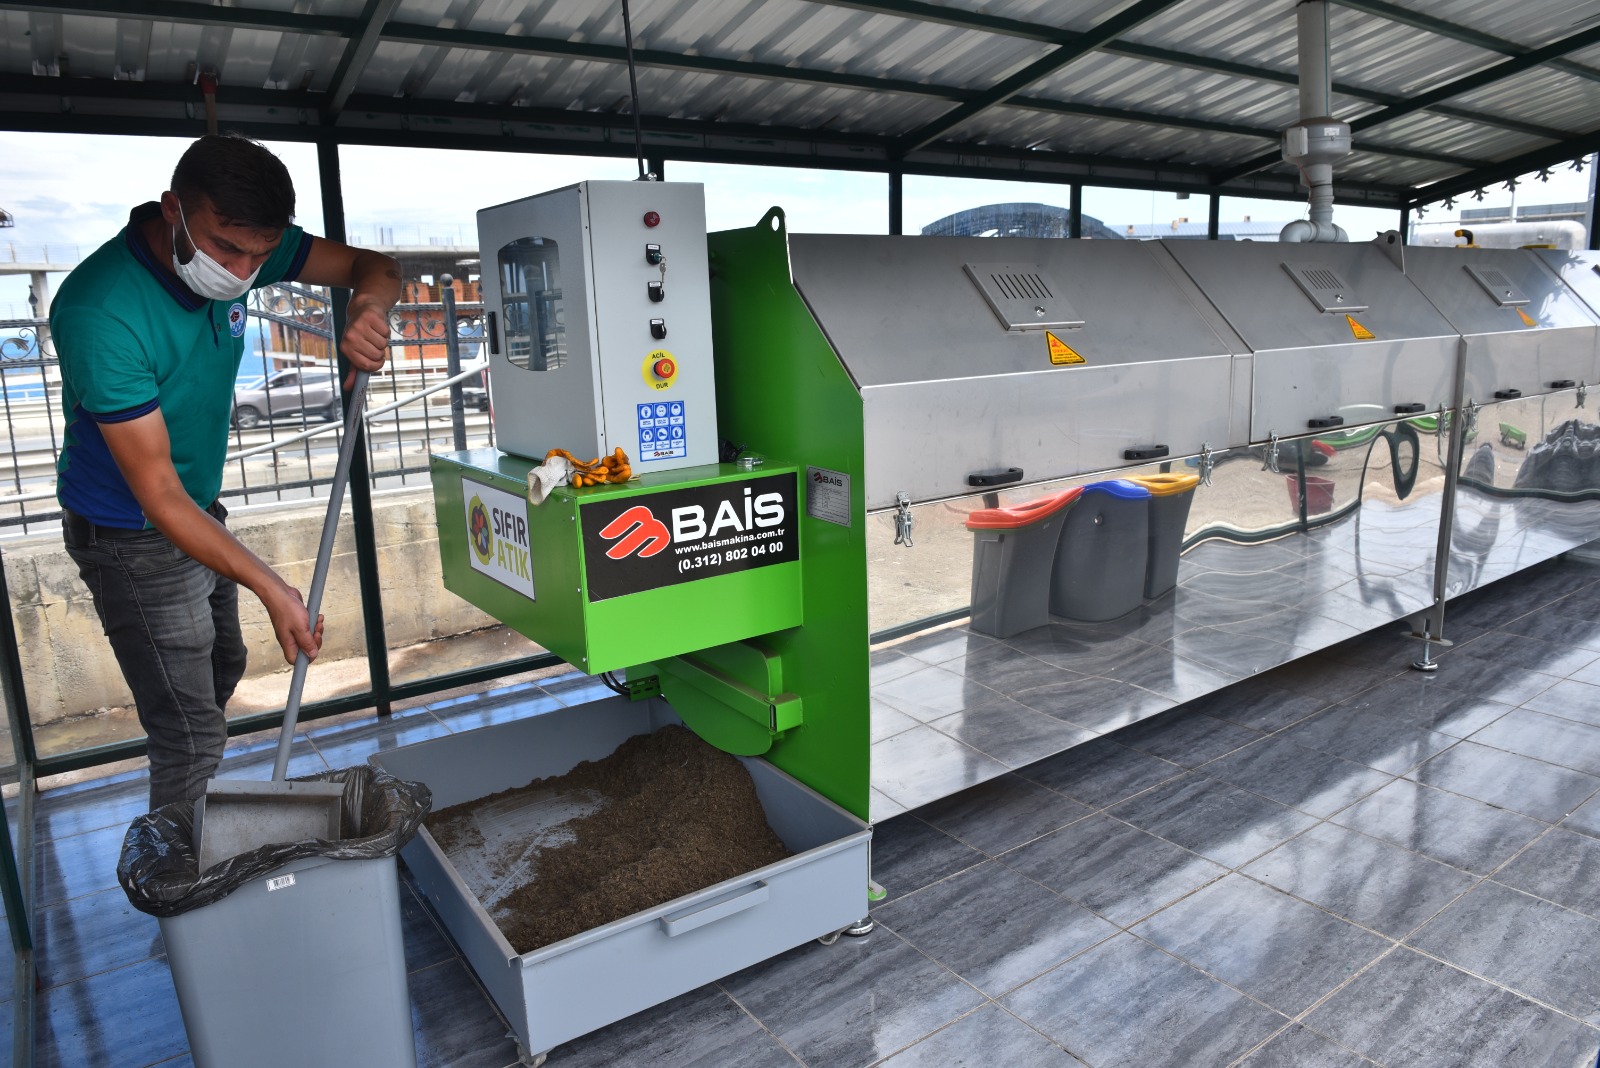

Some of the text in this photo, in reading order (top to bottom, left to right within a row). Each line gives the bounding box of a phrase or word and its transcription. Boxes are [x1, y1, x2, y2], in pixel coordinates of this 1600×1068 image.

[492, 507, 528, 547] SIFIR
[674, 528, 785, 555] www.baismakina.com.tr
[497, 539, 531, 581] ATIK
[678, 541, 784, 574] (0.312) 802 04 00
